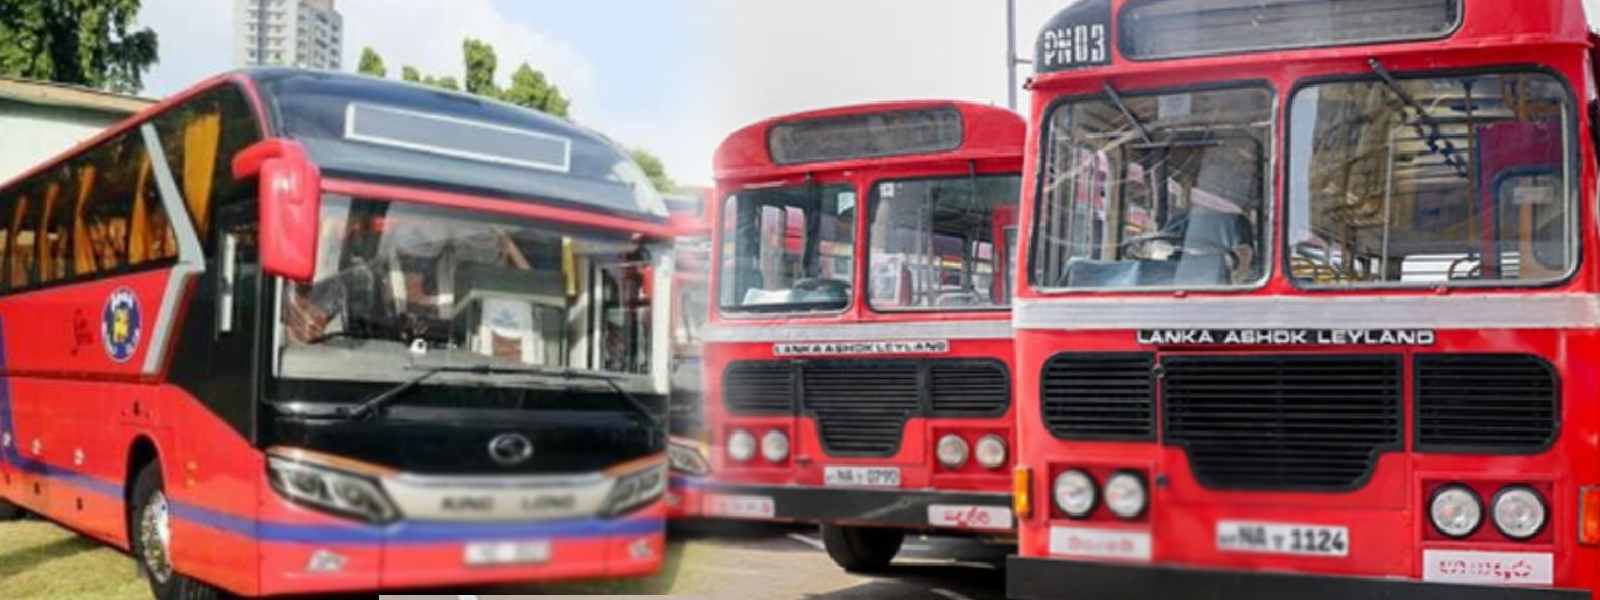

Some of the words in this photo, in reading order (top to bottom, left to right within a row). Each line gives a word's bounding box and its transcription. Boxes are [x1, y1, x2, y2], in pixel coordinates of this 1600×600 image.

[1136, 329, 1214, 345] LANKA
[1223, 329, 1307, 345] ASHOK
[1317, 329, 1435, 345] LEYLAND
[774, 344, 822, 354] LANKA
[824, 342, 872, 353] ASHOK
[873, 341, 947, 353] LEYLAND
[1237, 525, 1268, 545] NA
[1290, 528, 1346, 553] 1124
